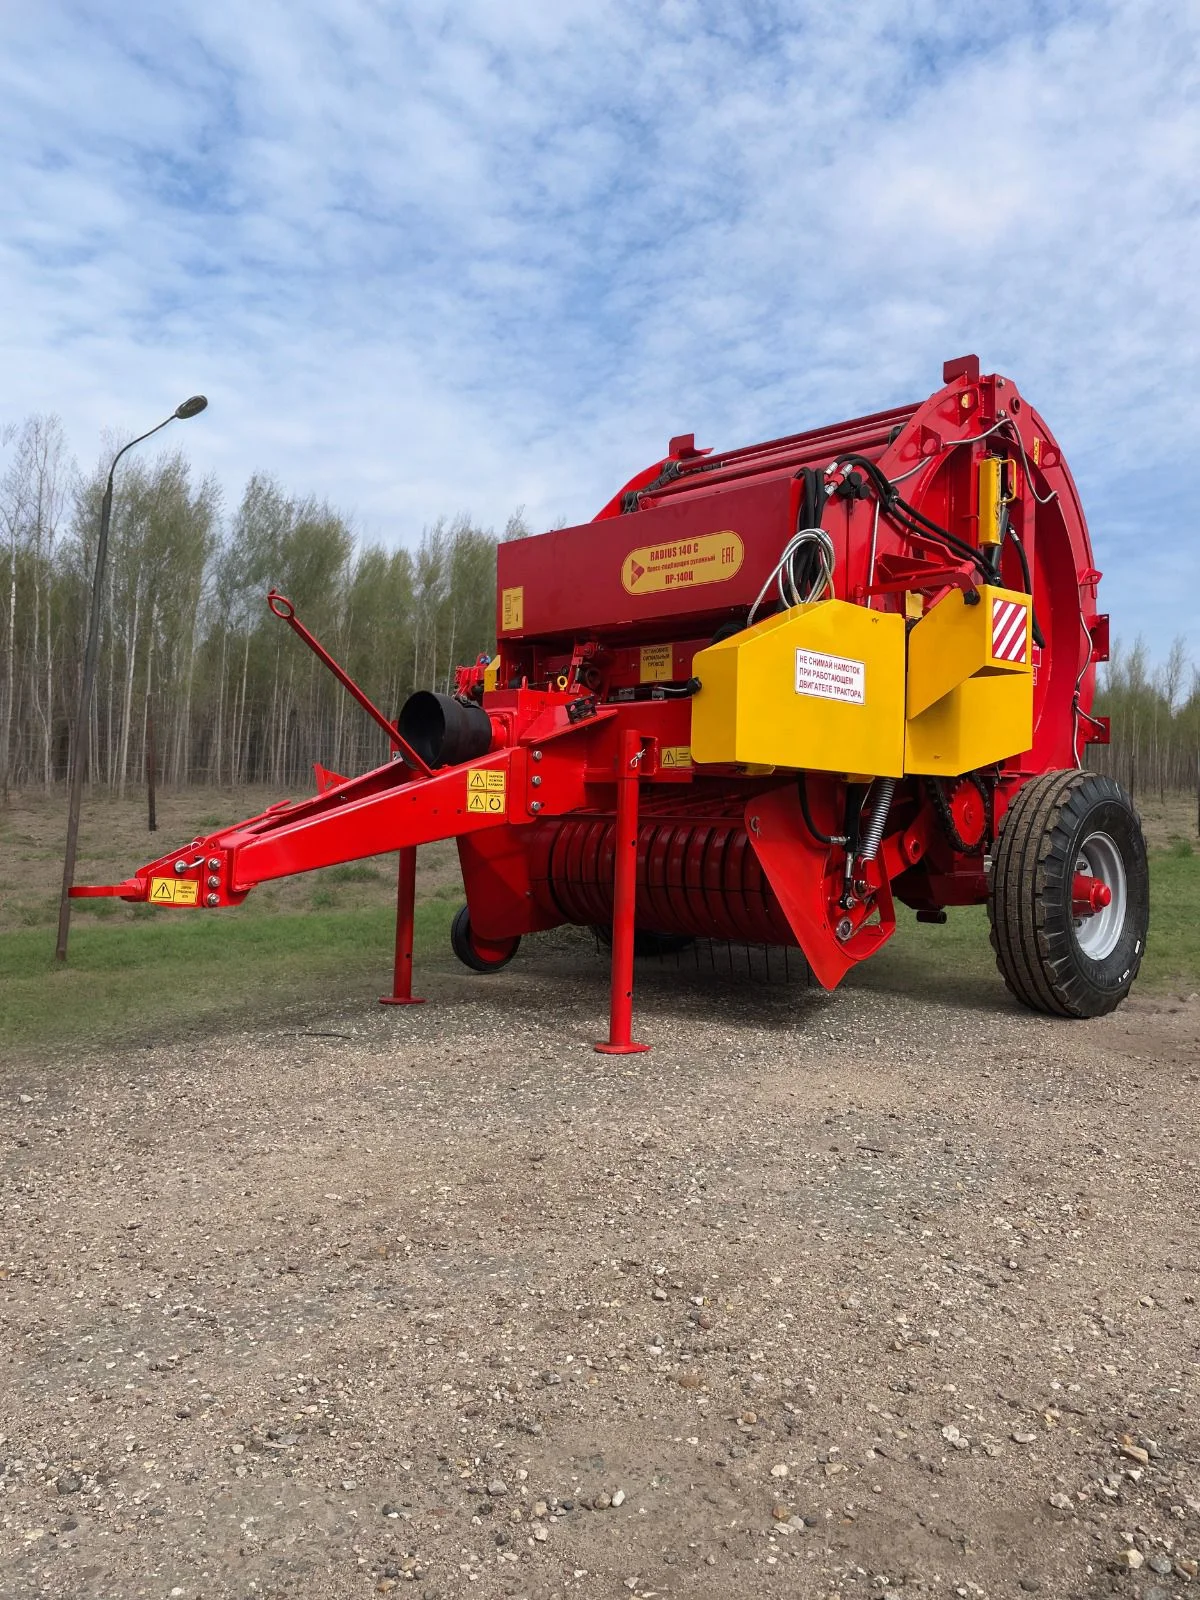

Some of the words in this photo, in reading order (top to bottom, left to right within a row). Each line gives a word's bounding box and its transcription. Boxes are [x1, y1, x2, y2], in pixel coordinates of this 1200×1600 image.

[650, 547, 677, 561] RADIUS
[679, 544, 692, 556] 140
[800, 655, 808, 664] НЕ
[809, 657, 833, 669] СНИМАЙ
[834, 663, 861, 675] НАМОТОК
[799, 667, 812, 676] ПРИ
[812, 670, 854, 685] РАБОТАЮЩЕМ
[799, 680, 833, 693] ДВИГАТЕЛЕ
[834, 686, 862, 698] ТРАКТОРА
